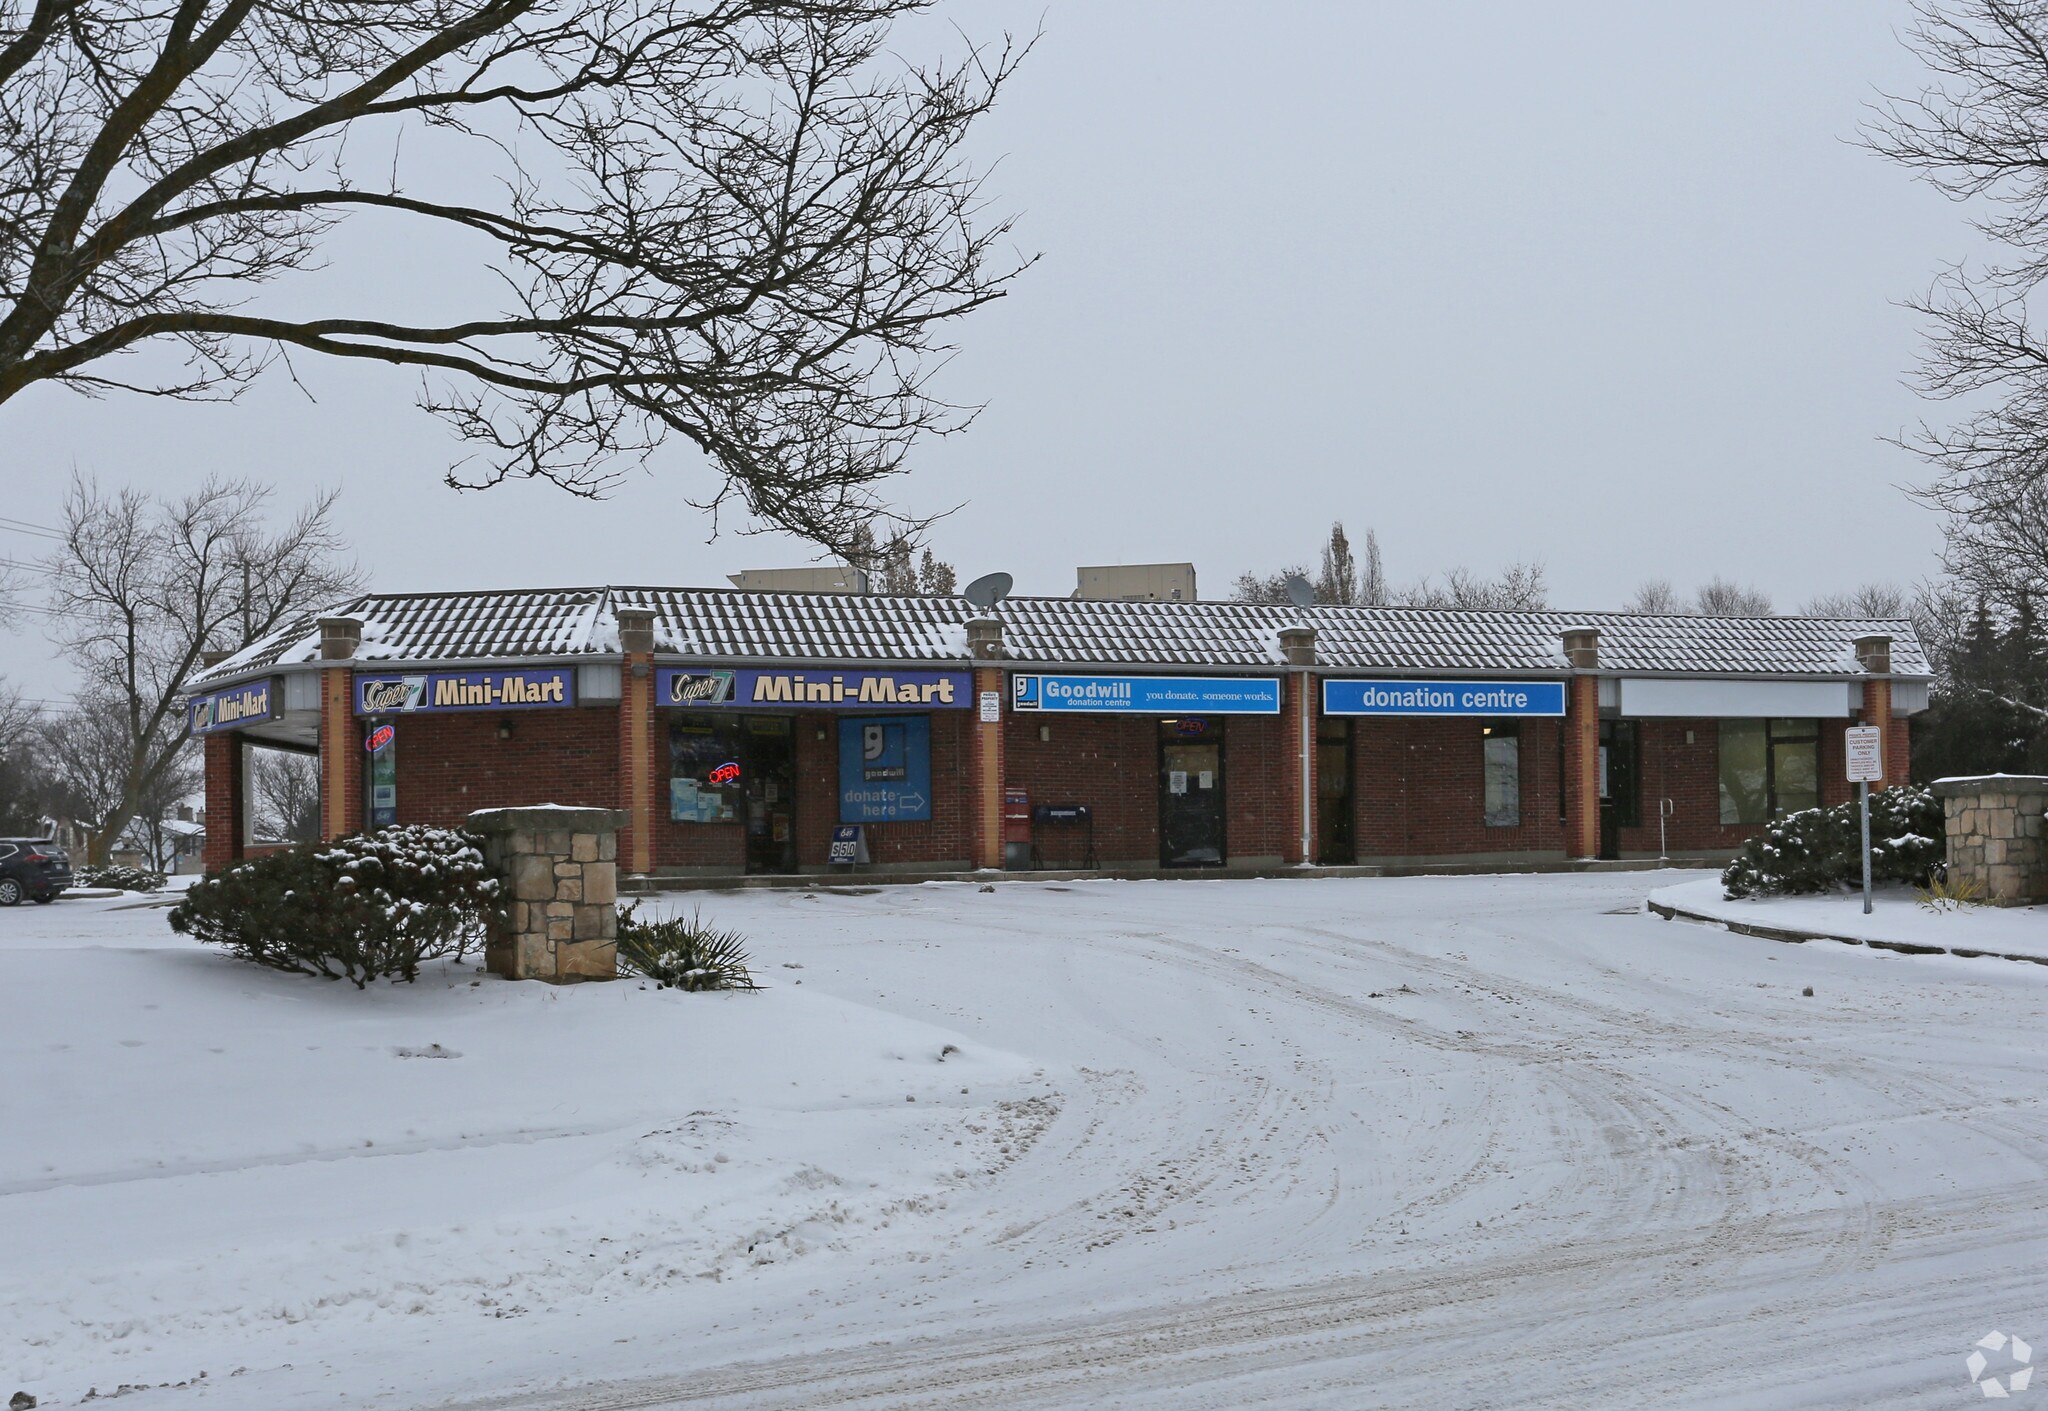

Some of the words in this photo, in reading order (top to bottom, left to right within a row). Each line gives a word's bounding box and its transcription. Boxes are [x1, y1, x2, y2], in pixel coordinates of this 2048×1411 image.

[363, 680, 411, 712] Super
[401, 675, 428, 711] 7
[434, 676, 563, 706] Mini-Mart
[671, 673, 716, 706] Super
[710, 670, 736, 704] 7
[752, 675, 954, 703] Mini-Mart
[1046, 681, 1131, 698] Goodwill
[1145, 692, 1163, 701] you
[1165, 690, 1199, 700] donate.
[1244, 691, 1274, 701] works.
[1067, 698, 1103, 706] donation
[1105, 699, 1131, 707] centre
[1363, 687, 1454, 708] donation
[1461, 689, 1528, 708] centre
[218, 688, 267, 723] Mini-Mart
[1177, 721, 1205, 732] OPEN
[709, 764, 742, 784] OPEN
[865, 768, 905, 780] goodwill
[844, 789, 896, 802] donate
[863, 804, 896, 816] here
